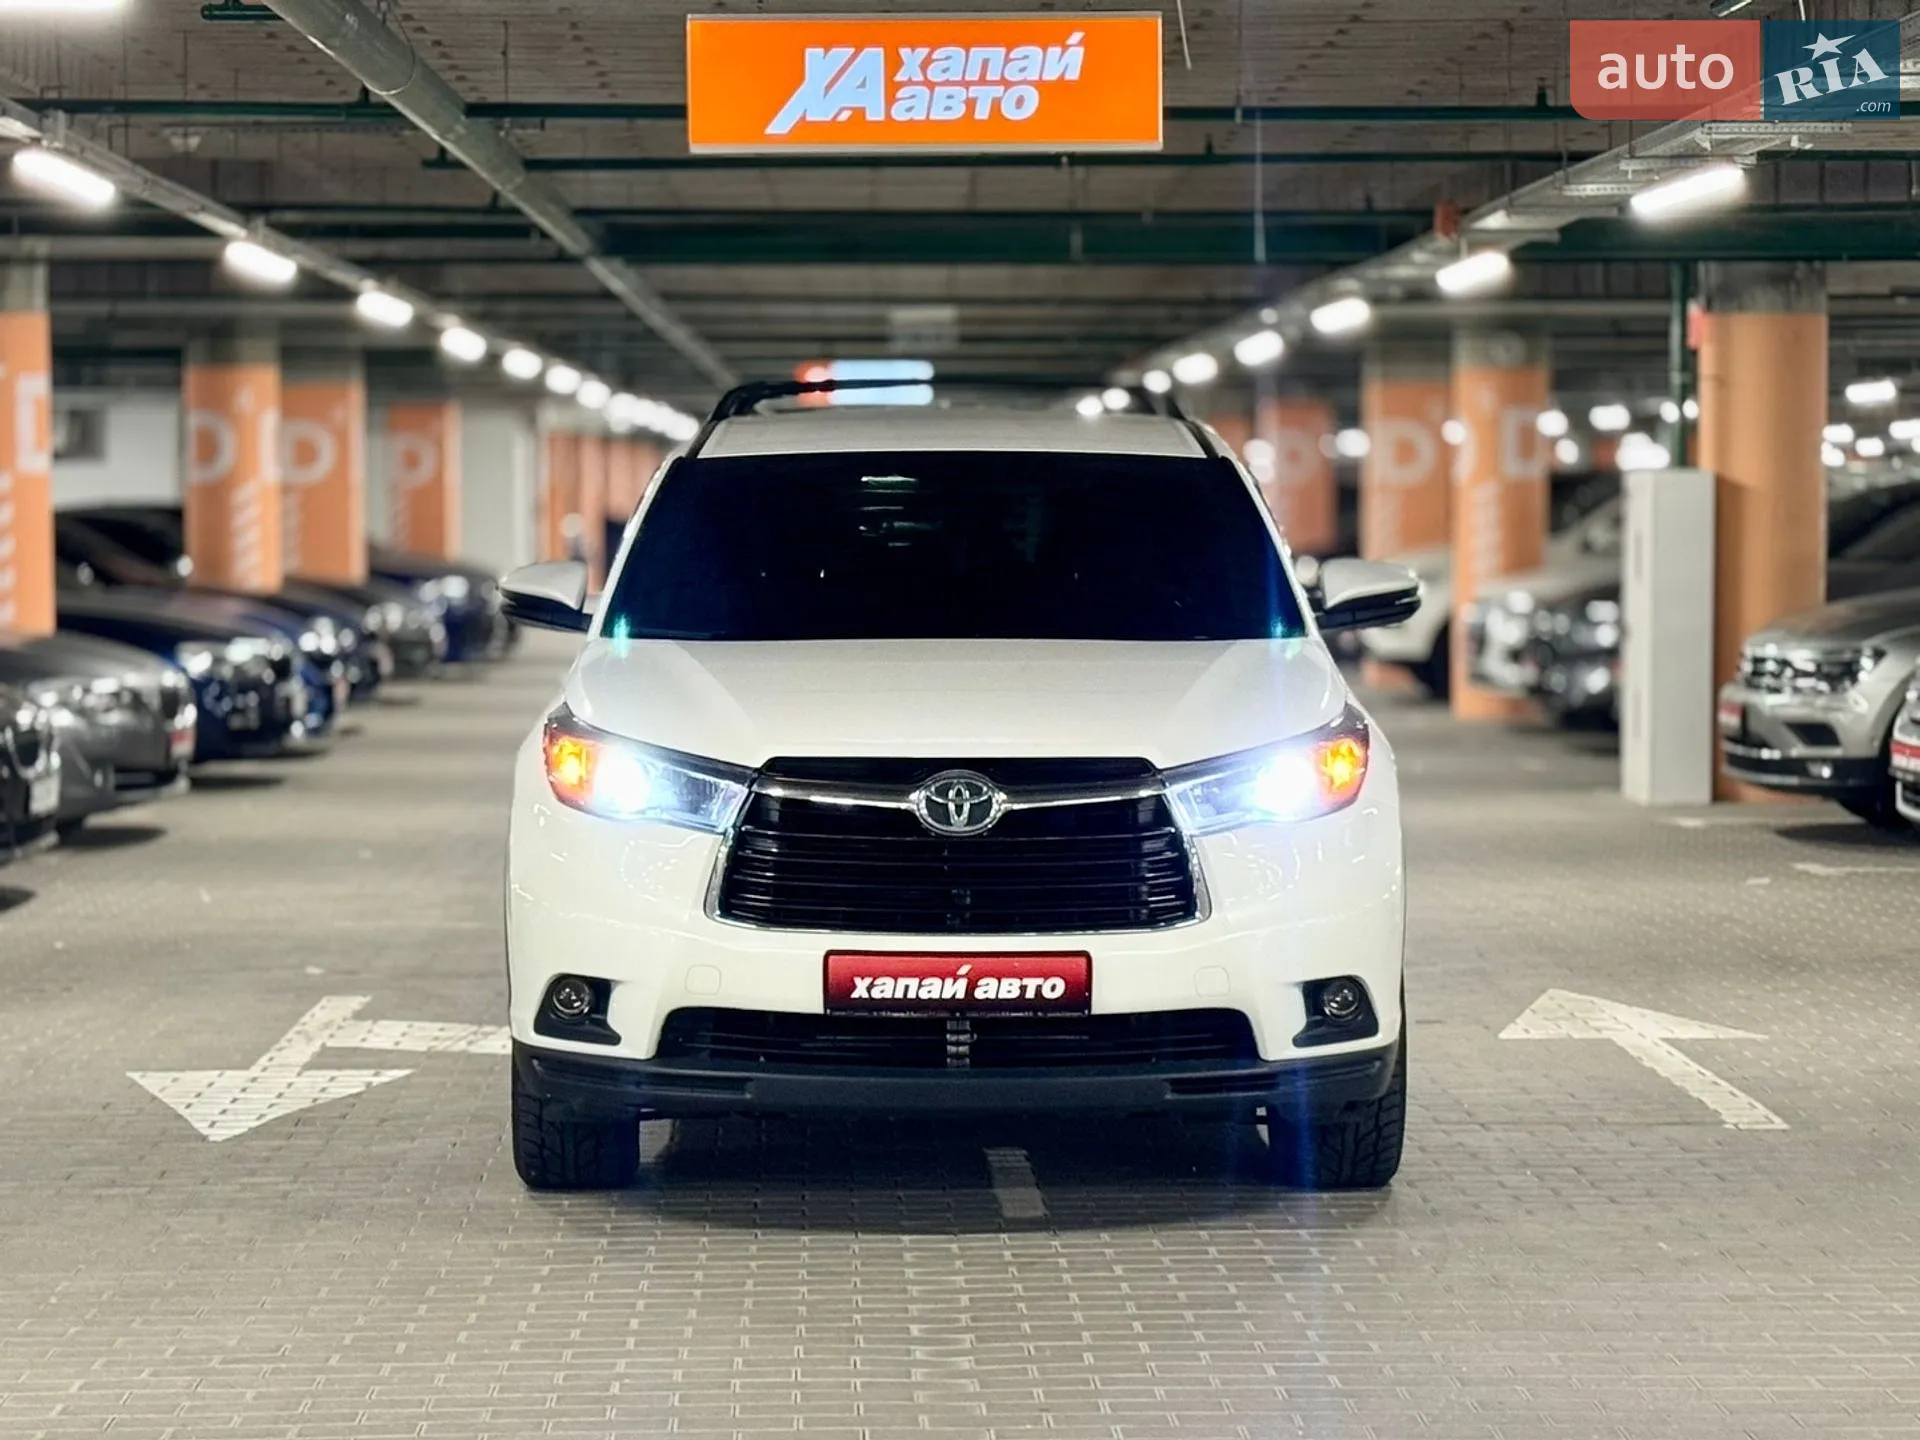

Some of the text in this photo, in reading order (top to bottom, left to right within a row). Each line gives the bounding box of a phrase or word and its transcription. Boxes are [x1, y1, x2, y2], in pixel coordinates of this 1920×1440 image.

[890, 84, 1040, 121] авто
[851, 965, 1066, 1000] хапай авто
